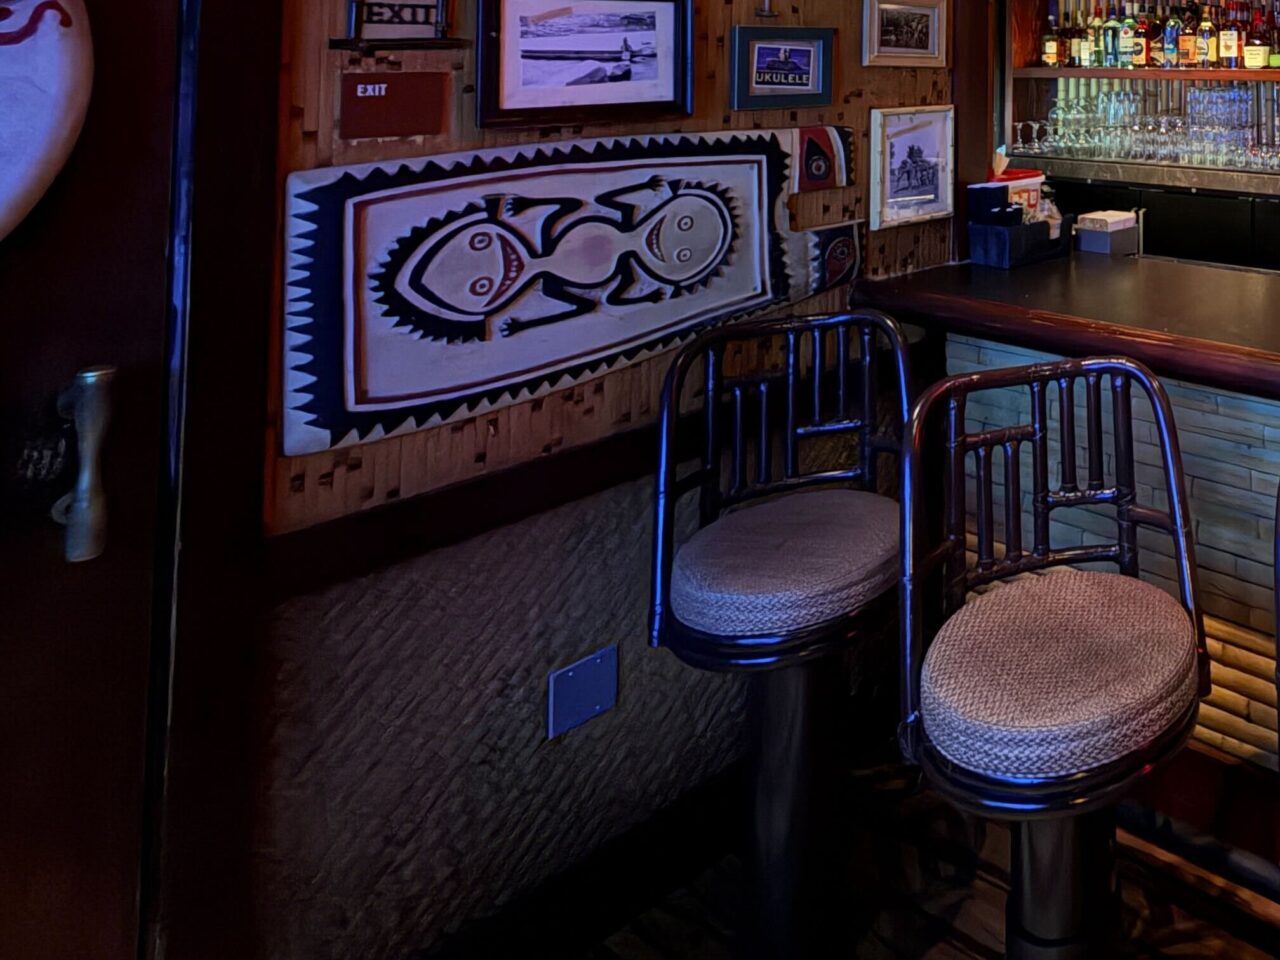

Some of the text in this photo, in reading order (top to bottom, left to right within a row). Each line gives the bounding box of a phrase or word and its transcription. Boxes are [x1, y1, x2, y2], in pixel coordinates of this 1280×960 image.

[362, 2, 437, 25] EXIT
[756, 72, 809, 83] UKULELE
[356, 83, 387, 96] EXIT
